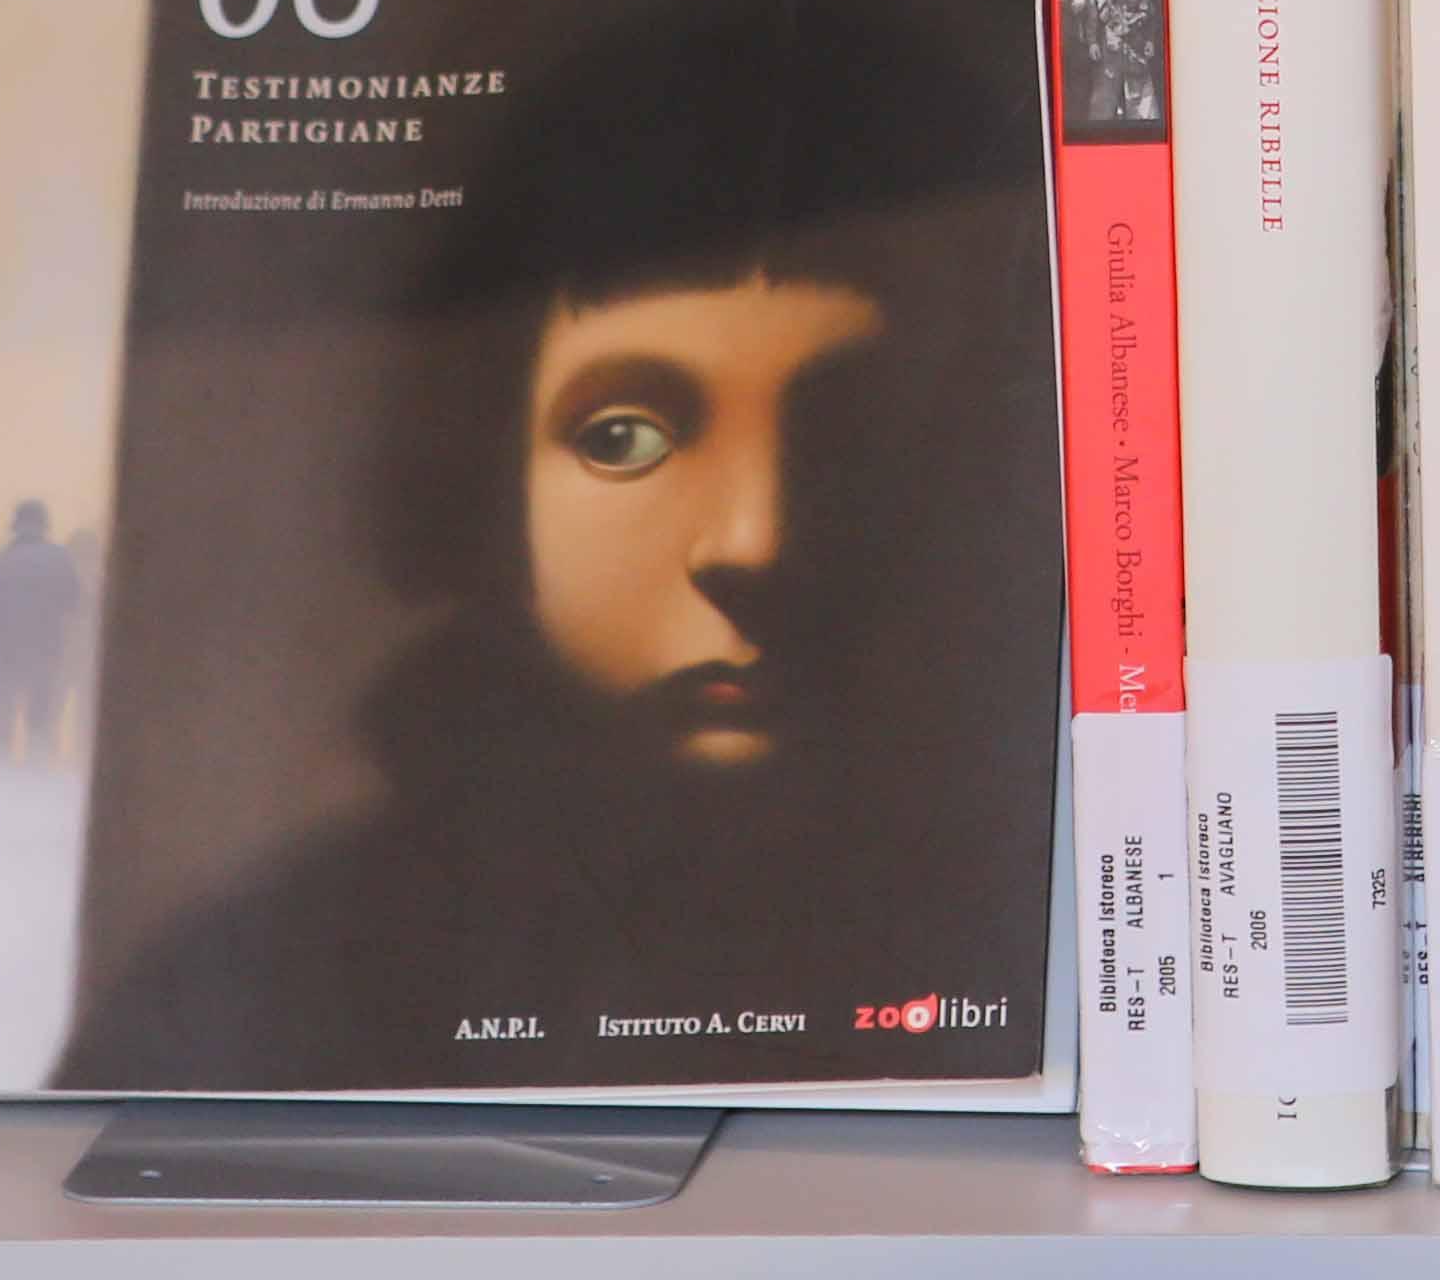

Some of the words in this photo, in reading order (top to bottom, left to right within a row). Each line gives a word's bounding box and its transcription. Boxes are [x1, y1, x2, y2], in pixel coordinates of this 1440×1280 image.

[1260, 101, 1283, 233] RIBELLE
[183, 190, 301, 211] Introduzione
[307, 189, 325, 210] di
[330, 189, 414, 210] Ermanno
[419, 187, 463, 208] Detti
[1098, 854, 1116, 921] Istoreco
[1125, 836, 1143, 929] ALBANESE
[1100, 928, 1117, 1012] Biblioteca
[455, 1018, 545, 1041] A.N.P.I.
[707, 1013, 732, 1035] A.
[854, 993, 1009, 1033] zoolibri
